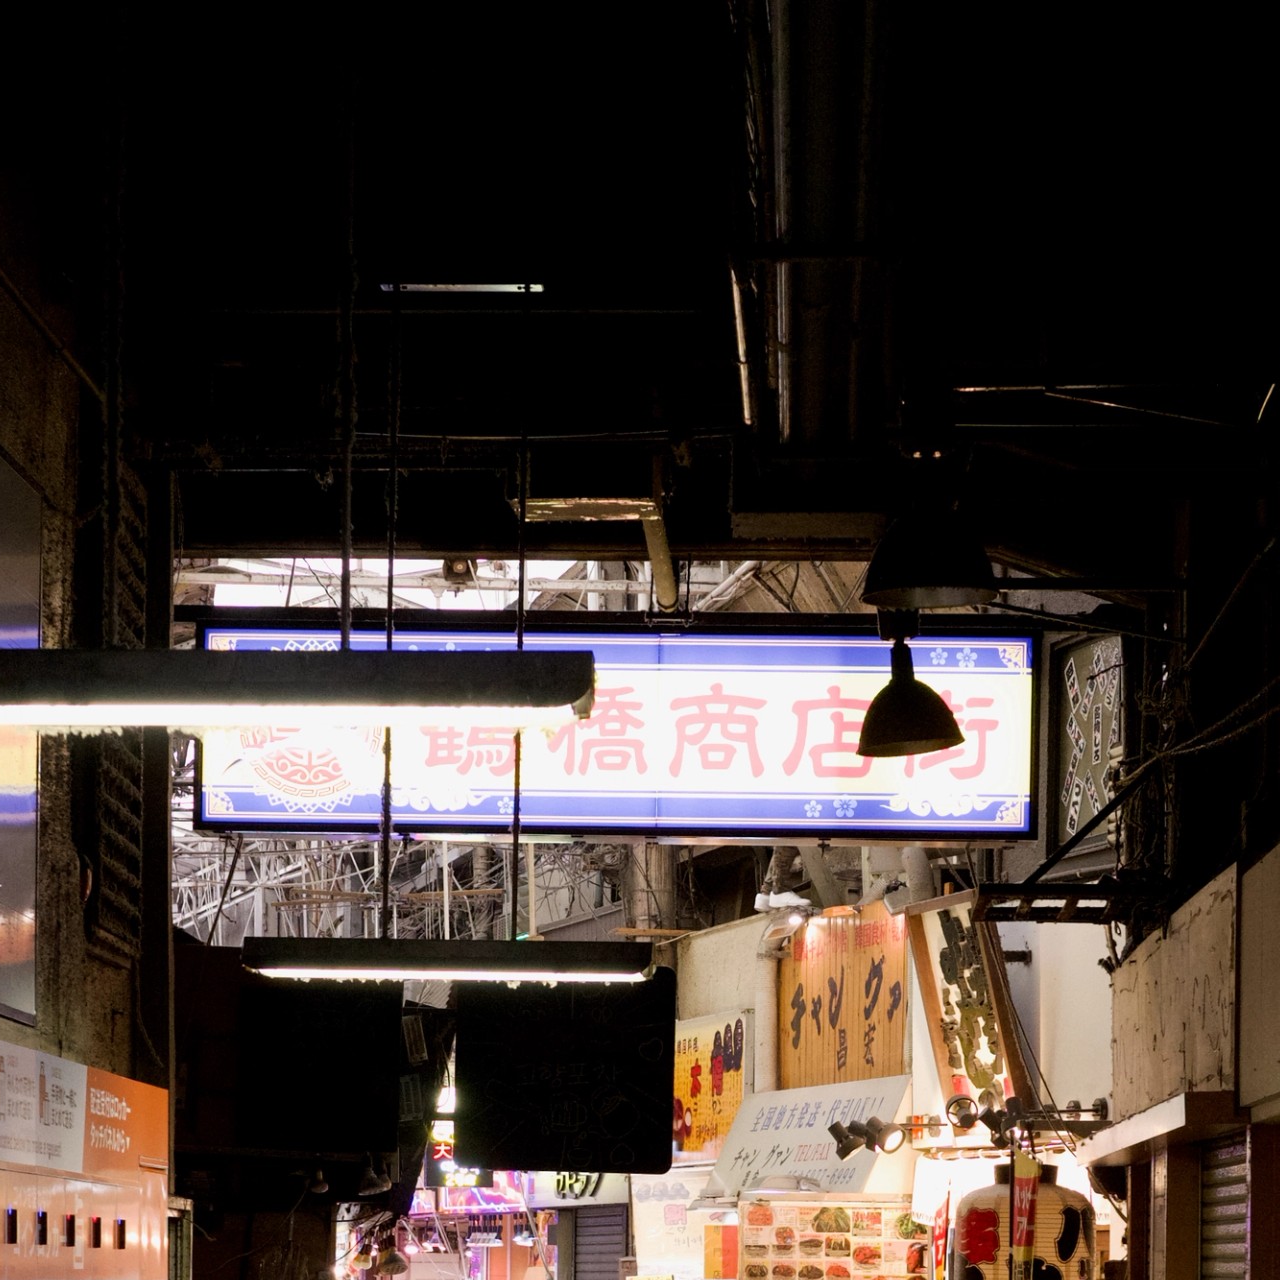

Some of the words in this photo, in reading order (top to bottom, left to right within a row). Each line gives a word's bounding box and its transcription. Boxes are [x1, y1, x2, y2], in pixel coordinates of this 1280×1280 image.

[419, 683, 1000, 780] 鶴橋商店街
[791, 964, 844, 1050] チャン
[863, 954, 909, 1024] グァ
